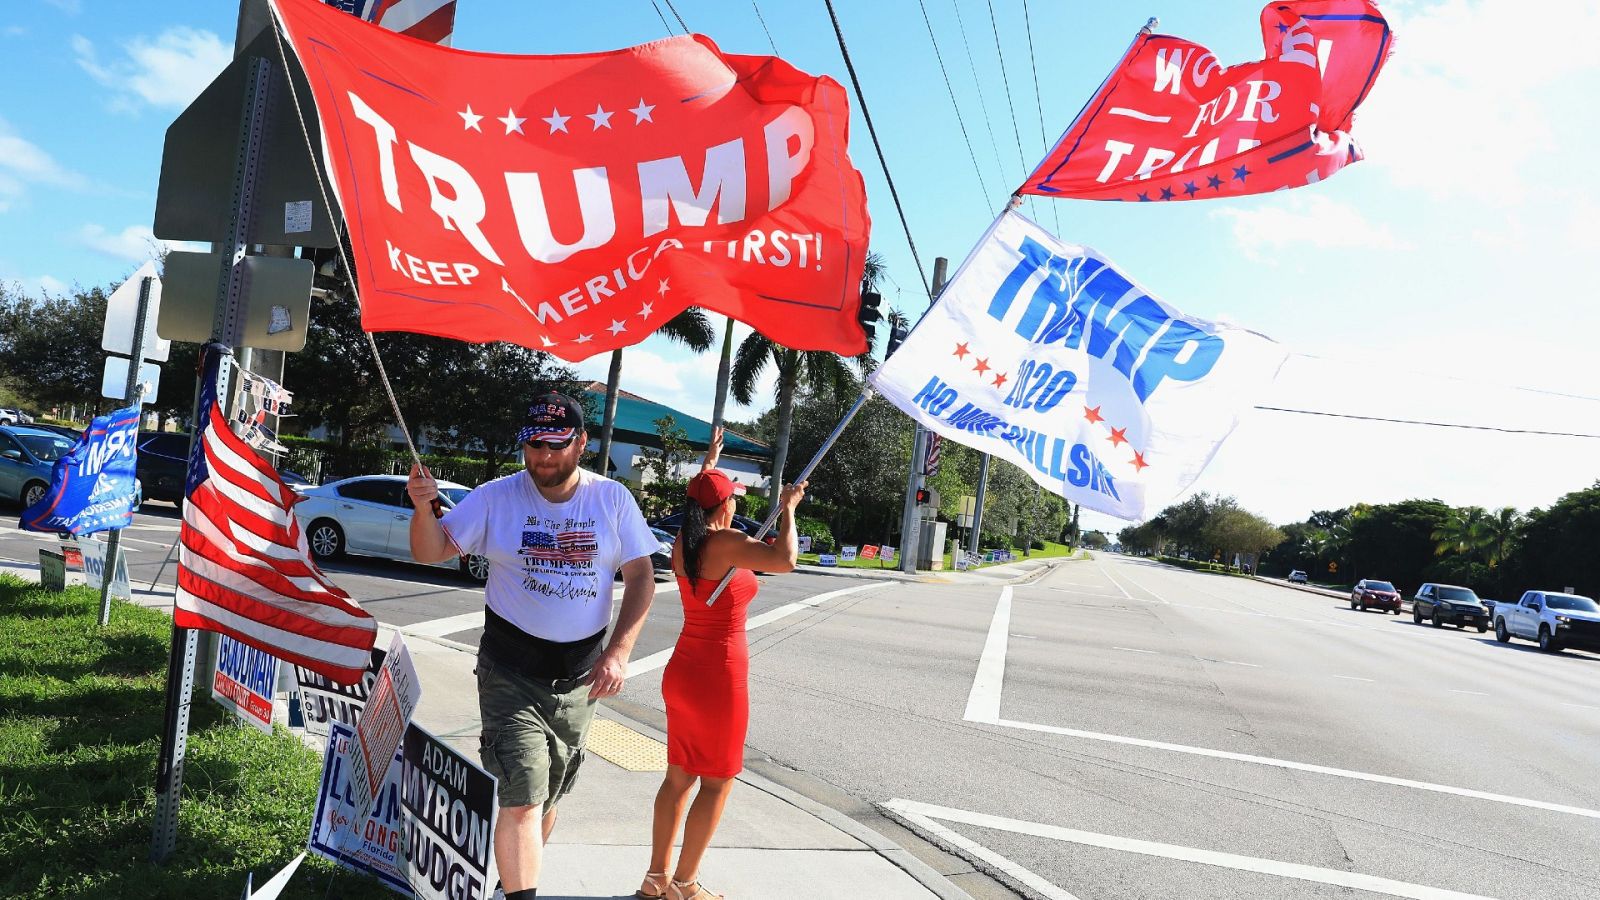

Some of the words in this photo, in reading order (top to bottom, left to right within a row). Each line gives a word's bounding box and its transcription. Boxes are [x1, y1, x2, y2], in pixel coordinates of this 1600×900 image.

[1183, 80, 1282, 138] FOR
[347, 91, 815, 266] TRUMP
[385, 240, 480, 286] KEEP
[912, 375, 958, 416] NO
[544, 518, 560, 532] The
[564, 517, 595, 531] People
[422, 740, 468, 796] ADAM
[330, 809, 349, 833] for
[402, 758, 488, 868] MYRON
[362, 840, 394, 862] Florida
[405, 819, 482, 900] JUDGE
